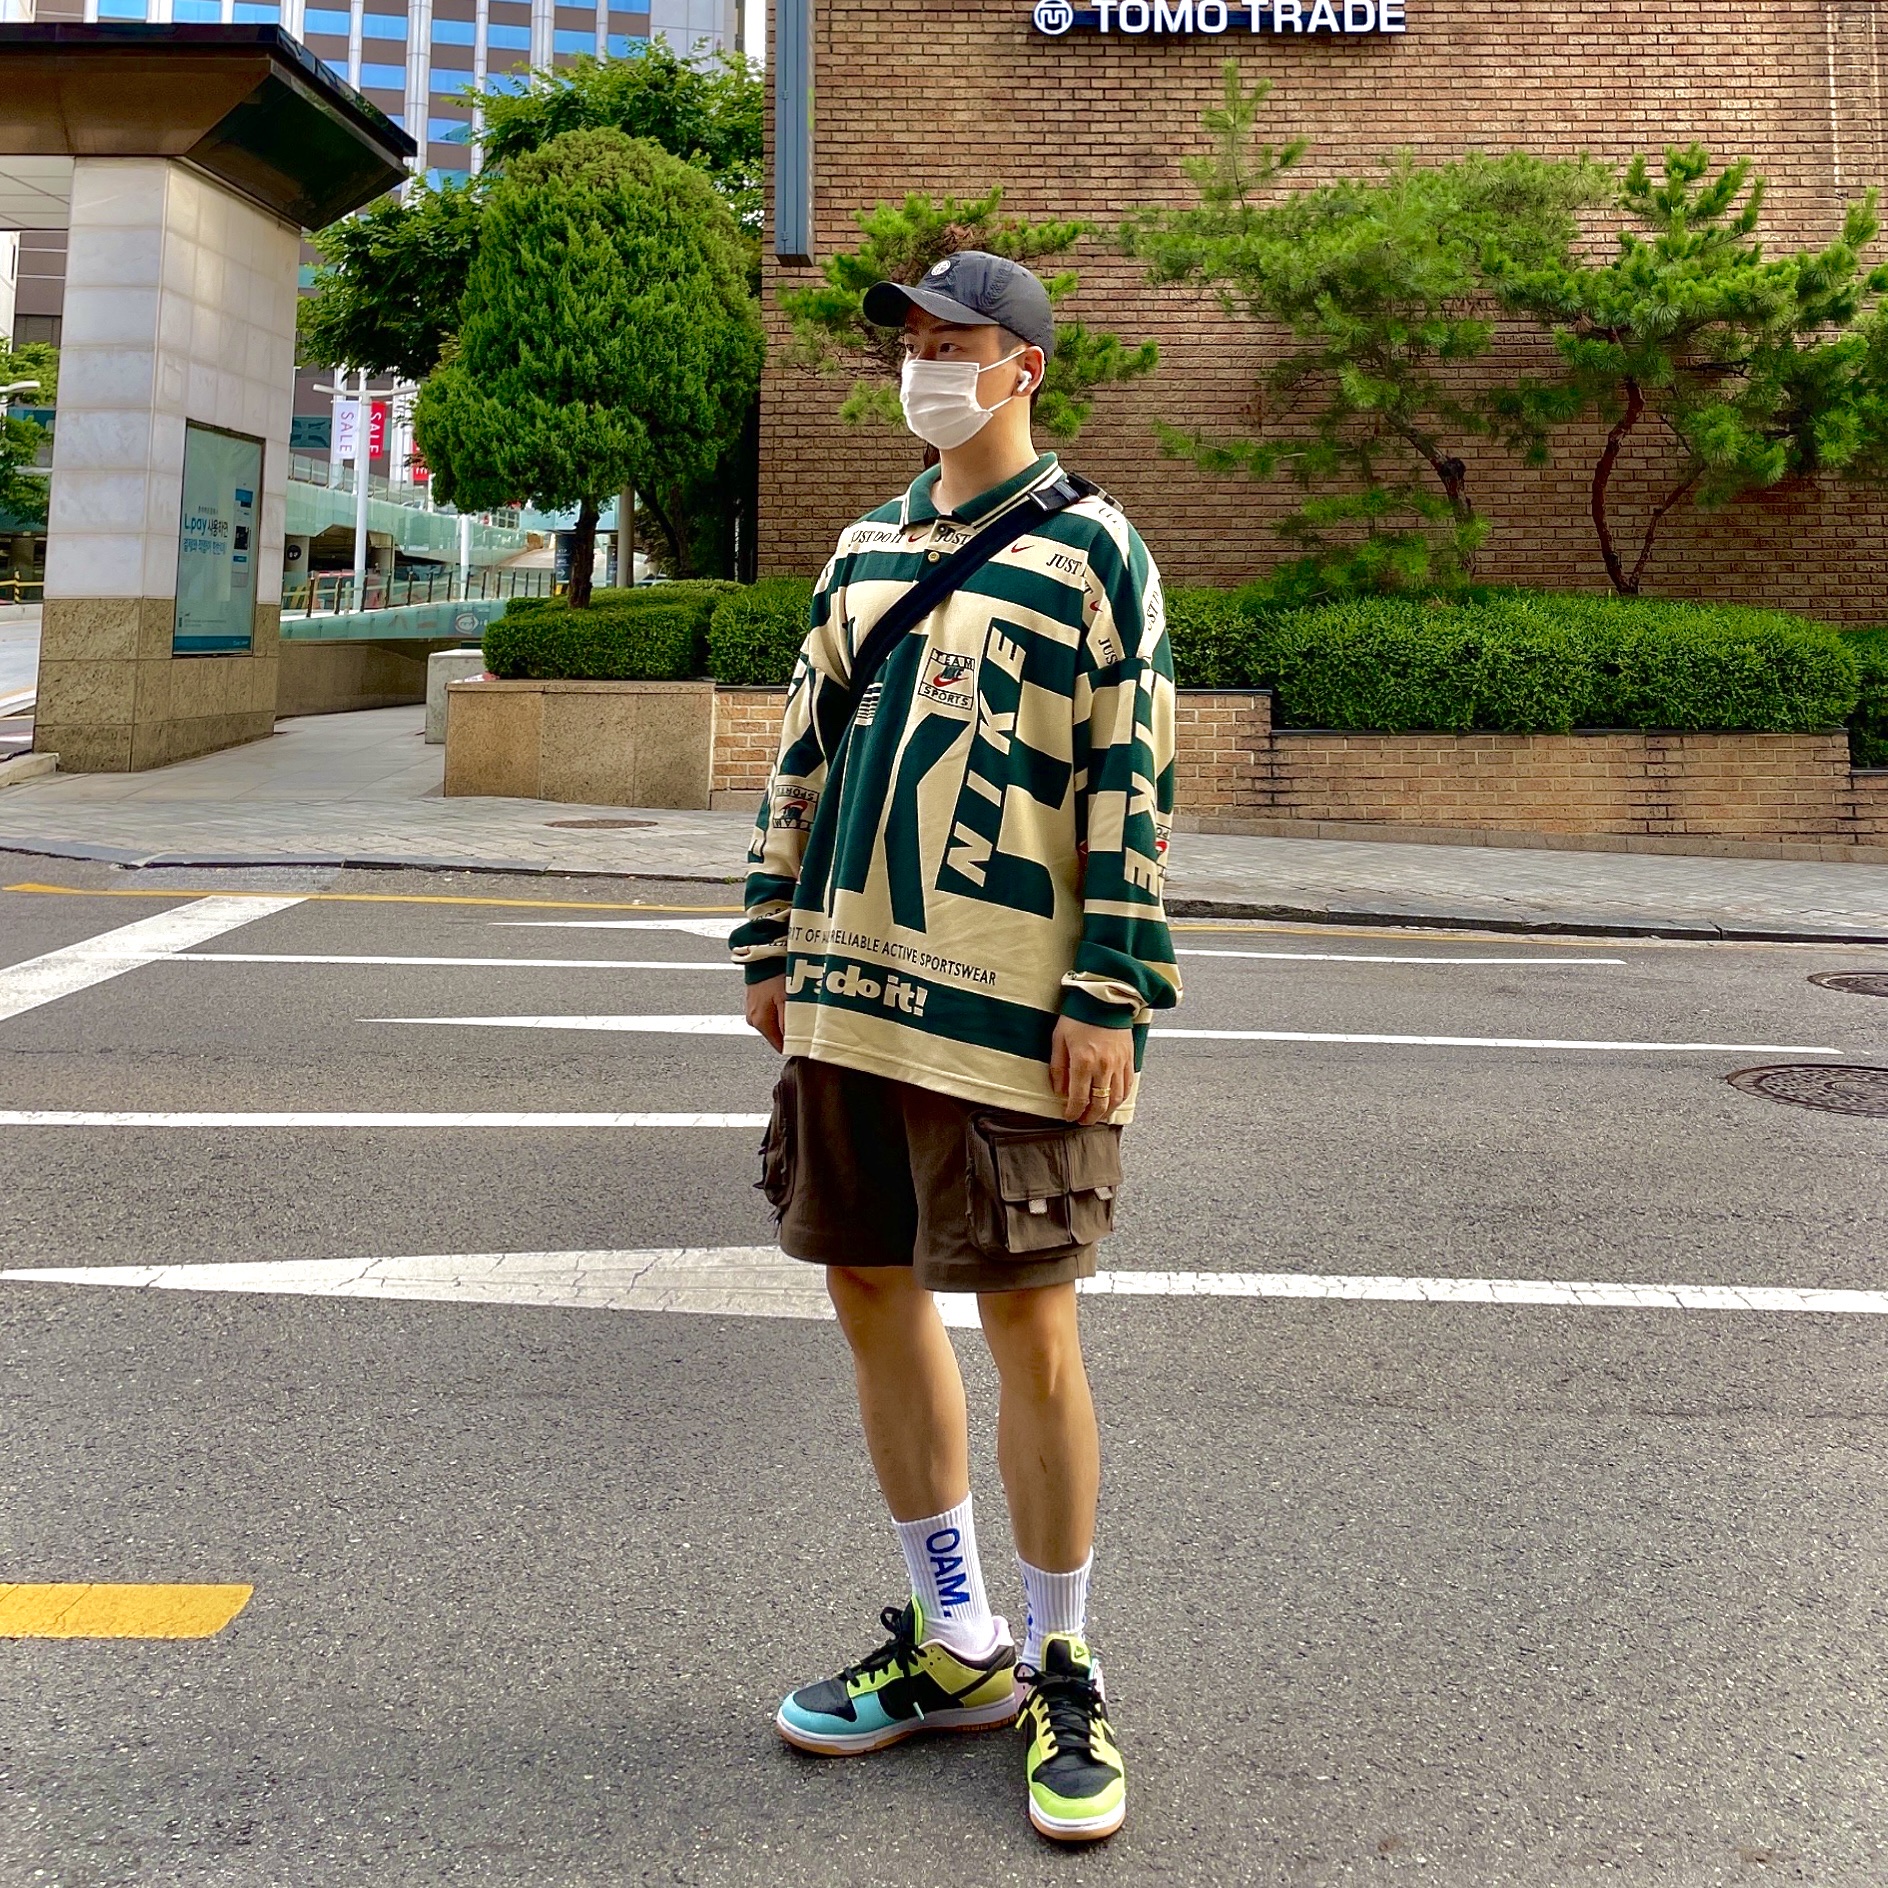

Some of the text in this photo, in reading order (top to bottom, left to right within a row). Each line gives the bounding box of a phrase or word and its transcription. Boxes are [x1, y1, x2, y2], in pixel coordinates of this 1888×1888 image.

[1091, 0, 1406, 33] TOMO TRADE
[340, 411, 354, 452] SALE
[369, 411, 382, 453] SALE
[185, 513, 207, 536] Lpay
[874, 532, 892, 543] DO
[1046, 553, 1082, 575] JUST
[935, 650, 973, 670] TEAM
[1098, 638, 1118, 665] JUS
[923, 686, 969, 706] SPORTS
[946, 626, 1027, 888] NIKE
[805, 926, 821, 943] OF
[831, 929, 881, 953] RELIABLE
[881, 941, 917, 964] ACTIVE
[920, 952, 996, 987] SPORTSWEAR
[826, 965, 881, 998] do
[883, 975, 928, 1017] it!
[926, 1528, 970, 1618] OAM.
